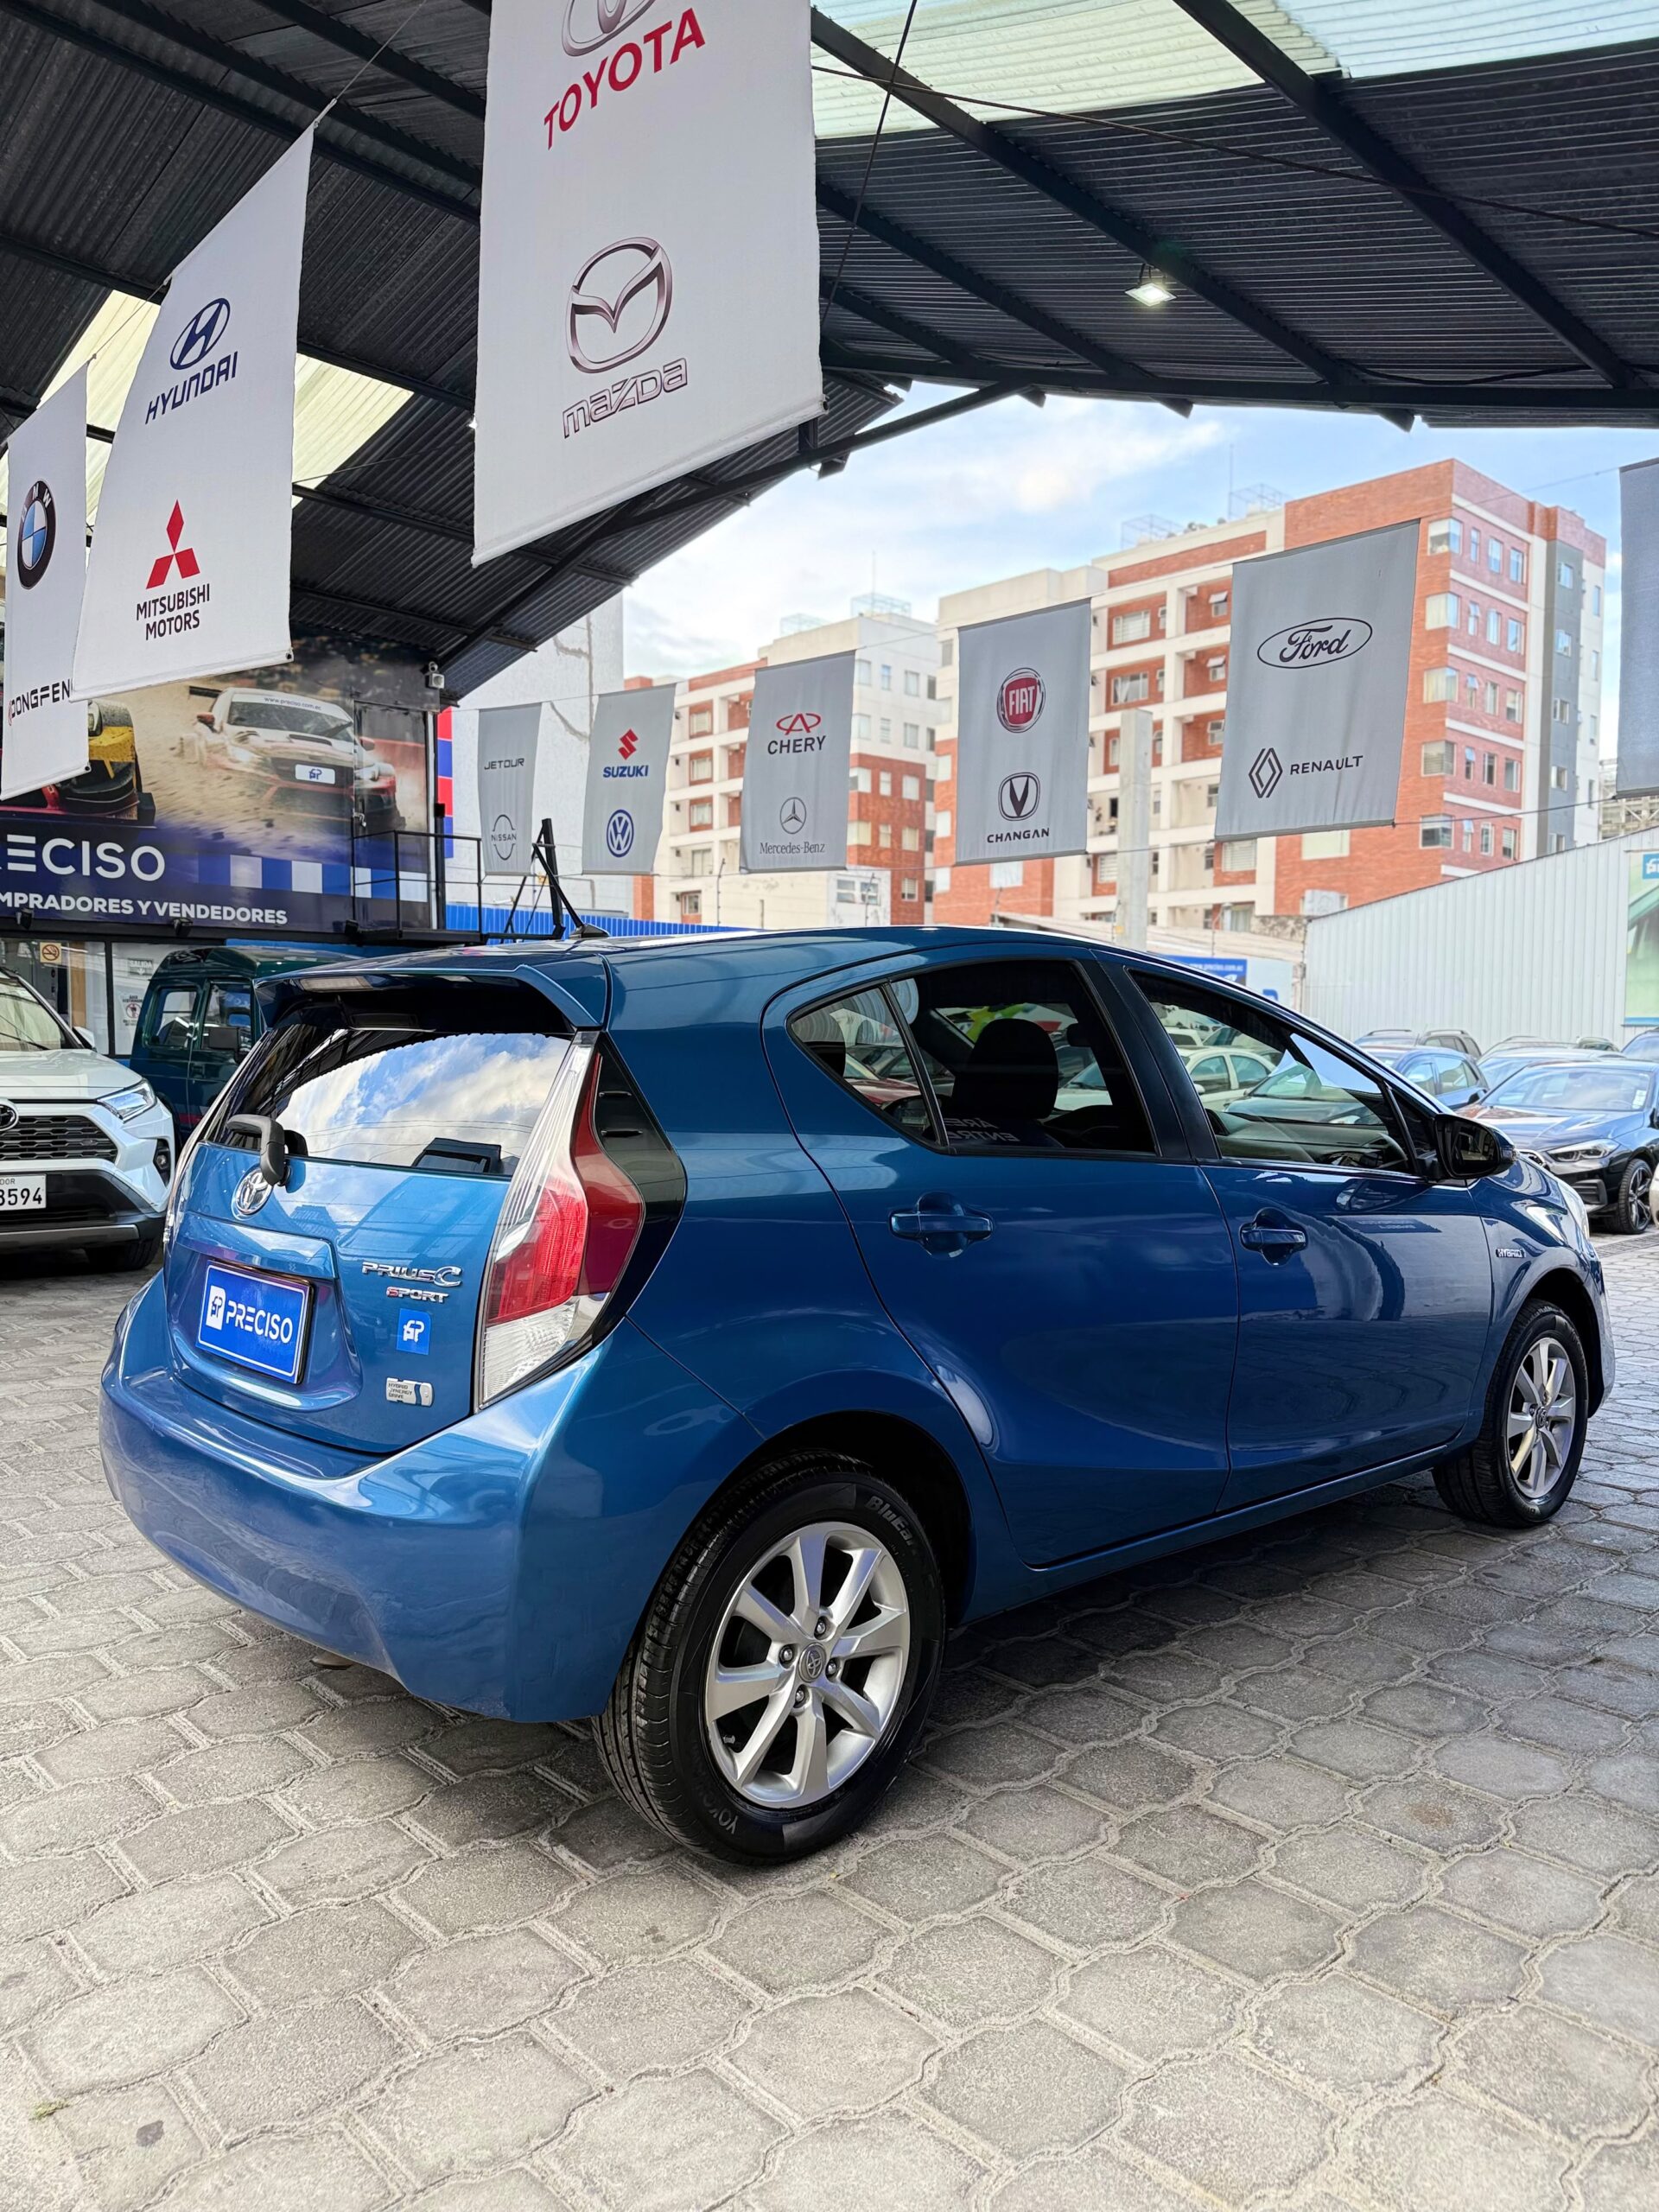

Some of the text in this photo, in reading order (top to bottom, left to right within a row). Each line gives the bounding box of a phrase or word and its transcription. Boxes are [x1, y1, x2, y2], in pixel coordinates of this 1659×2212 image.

[543, 8, 706, 150] TOYOTA
[145, 350, 238, 425] HYUNDAI
[136, 583, 210, 620] MITSUBISHI
[145, 609, 200, 640] MOTORS
[1279, 624, 1352, 663] Ford
[11, 677, 73, 719] DONGFEN
[1009, 685, 1036, 715] FIAT
[767, 735, 826, 755] CHERY
[484, 758, 525, 770] JETOUR
[602, 765, 649, 779] SUZUKI
[1290, 754, 1363, 776] RENAULT
[491, 833, 518, 842] NISSAN
[987, 828, 1050, 843] CHANGAN
[0, 834, 166, 881] ECISO
[760, 842, 826, 855] Mercedes-Benz
[137, 900, 151, 916] Y
[154, 901, 288, 925] VENDEDORES
[130, 960, 153, 969] SALIDA
[385, 1286, 449, 1303] SPORT
[226, 1300, 293, 1344] PRECISO
